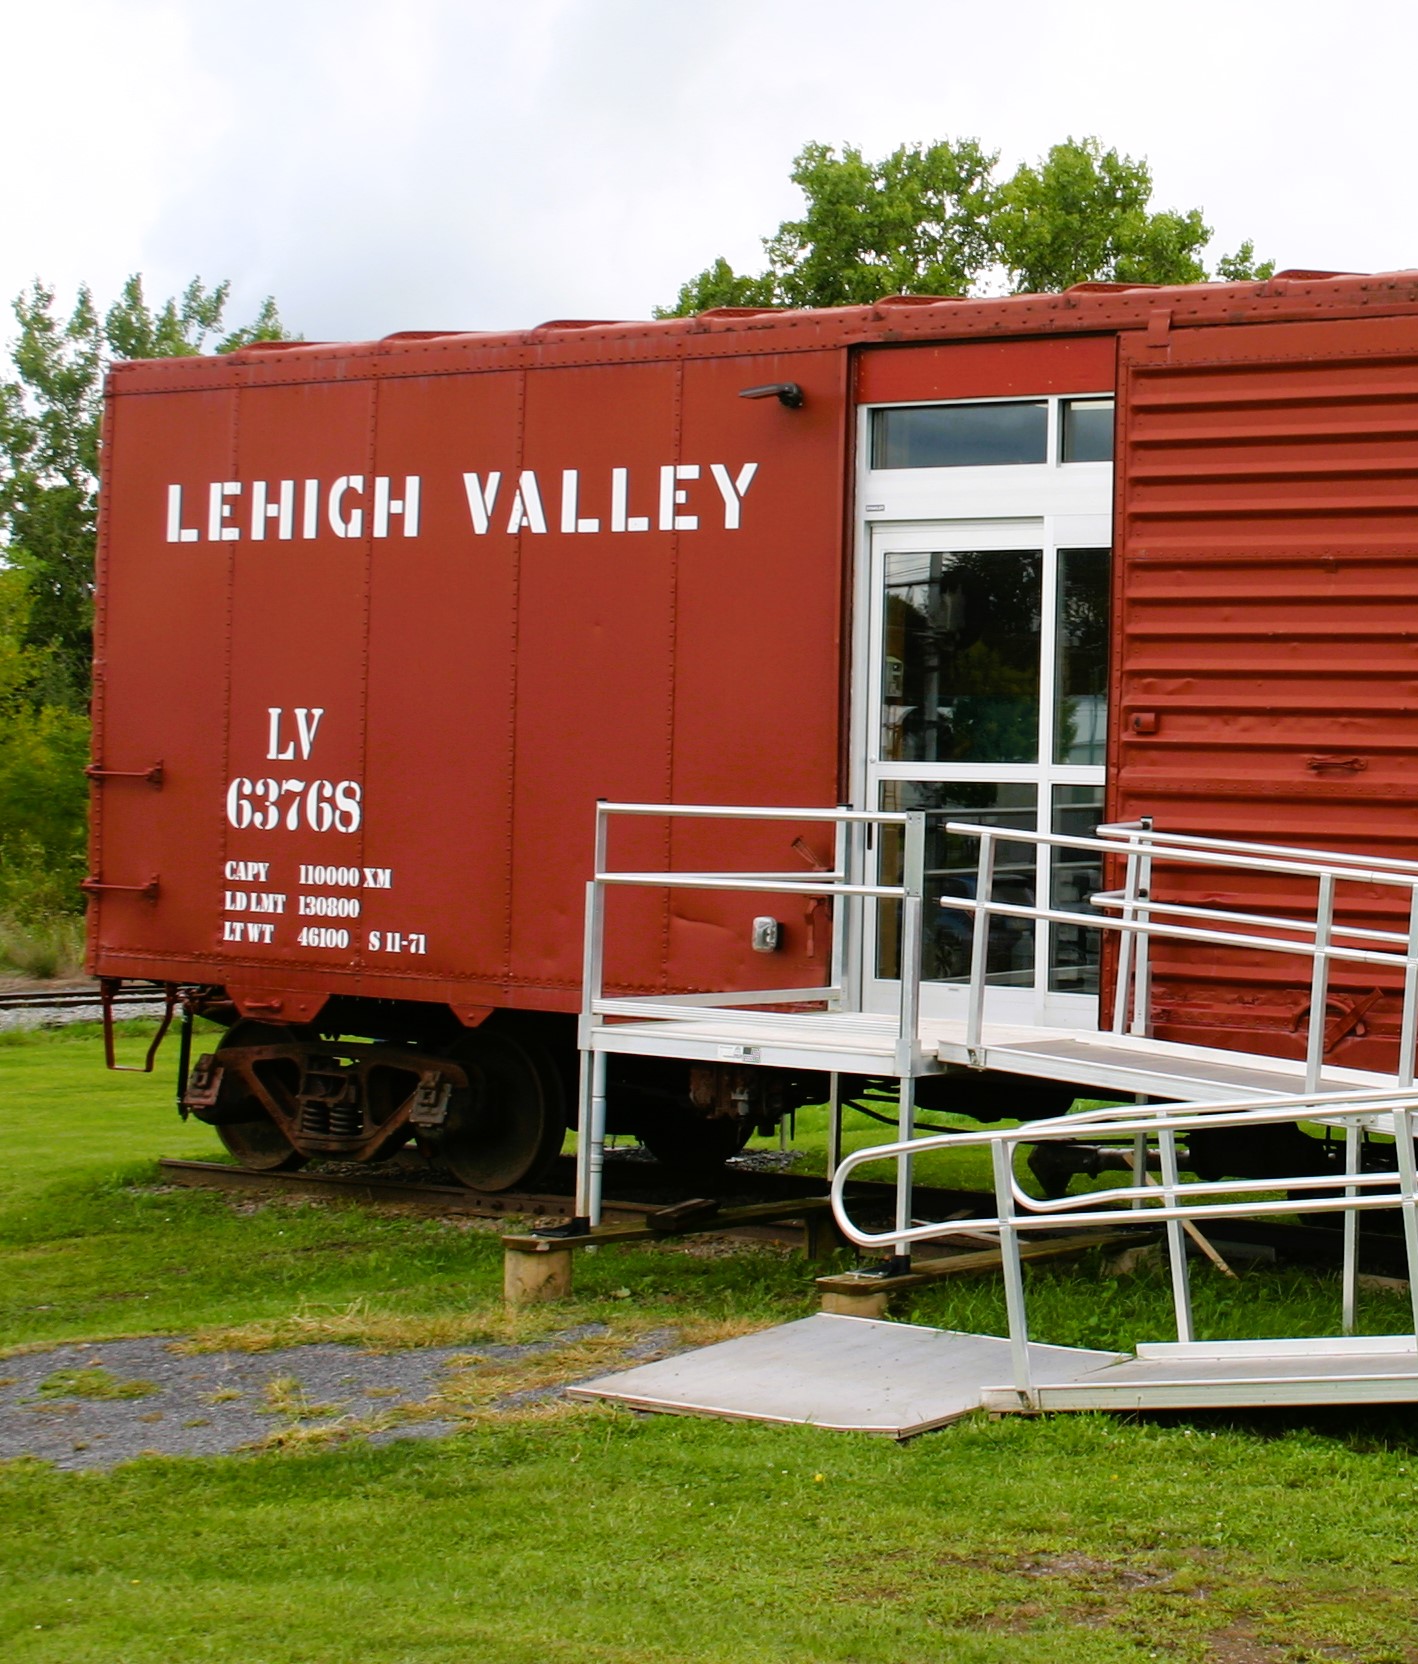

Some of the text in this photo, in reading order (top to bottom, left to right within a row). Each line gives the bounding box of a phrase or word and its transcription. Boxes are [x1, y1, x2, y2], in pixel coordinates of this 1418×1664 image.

[167, 463, 757, 542] LEHIGH VALLEY
[267, 708, 323, 760] LV
[227, 778, 361, 833] 63768
[224, 860, 392, 889] CAPY 110000 XM
[224, 890, 360, 918] LD LMT 130800
[222, 921, 426, 955] LT WT 46100 S 11-71
